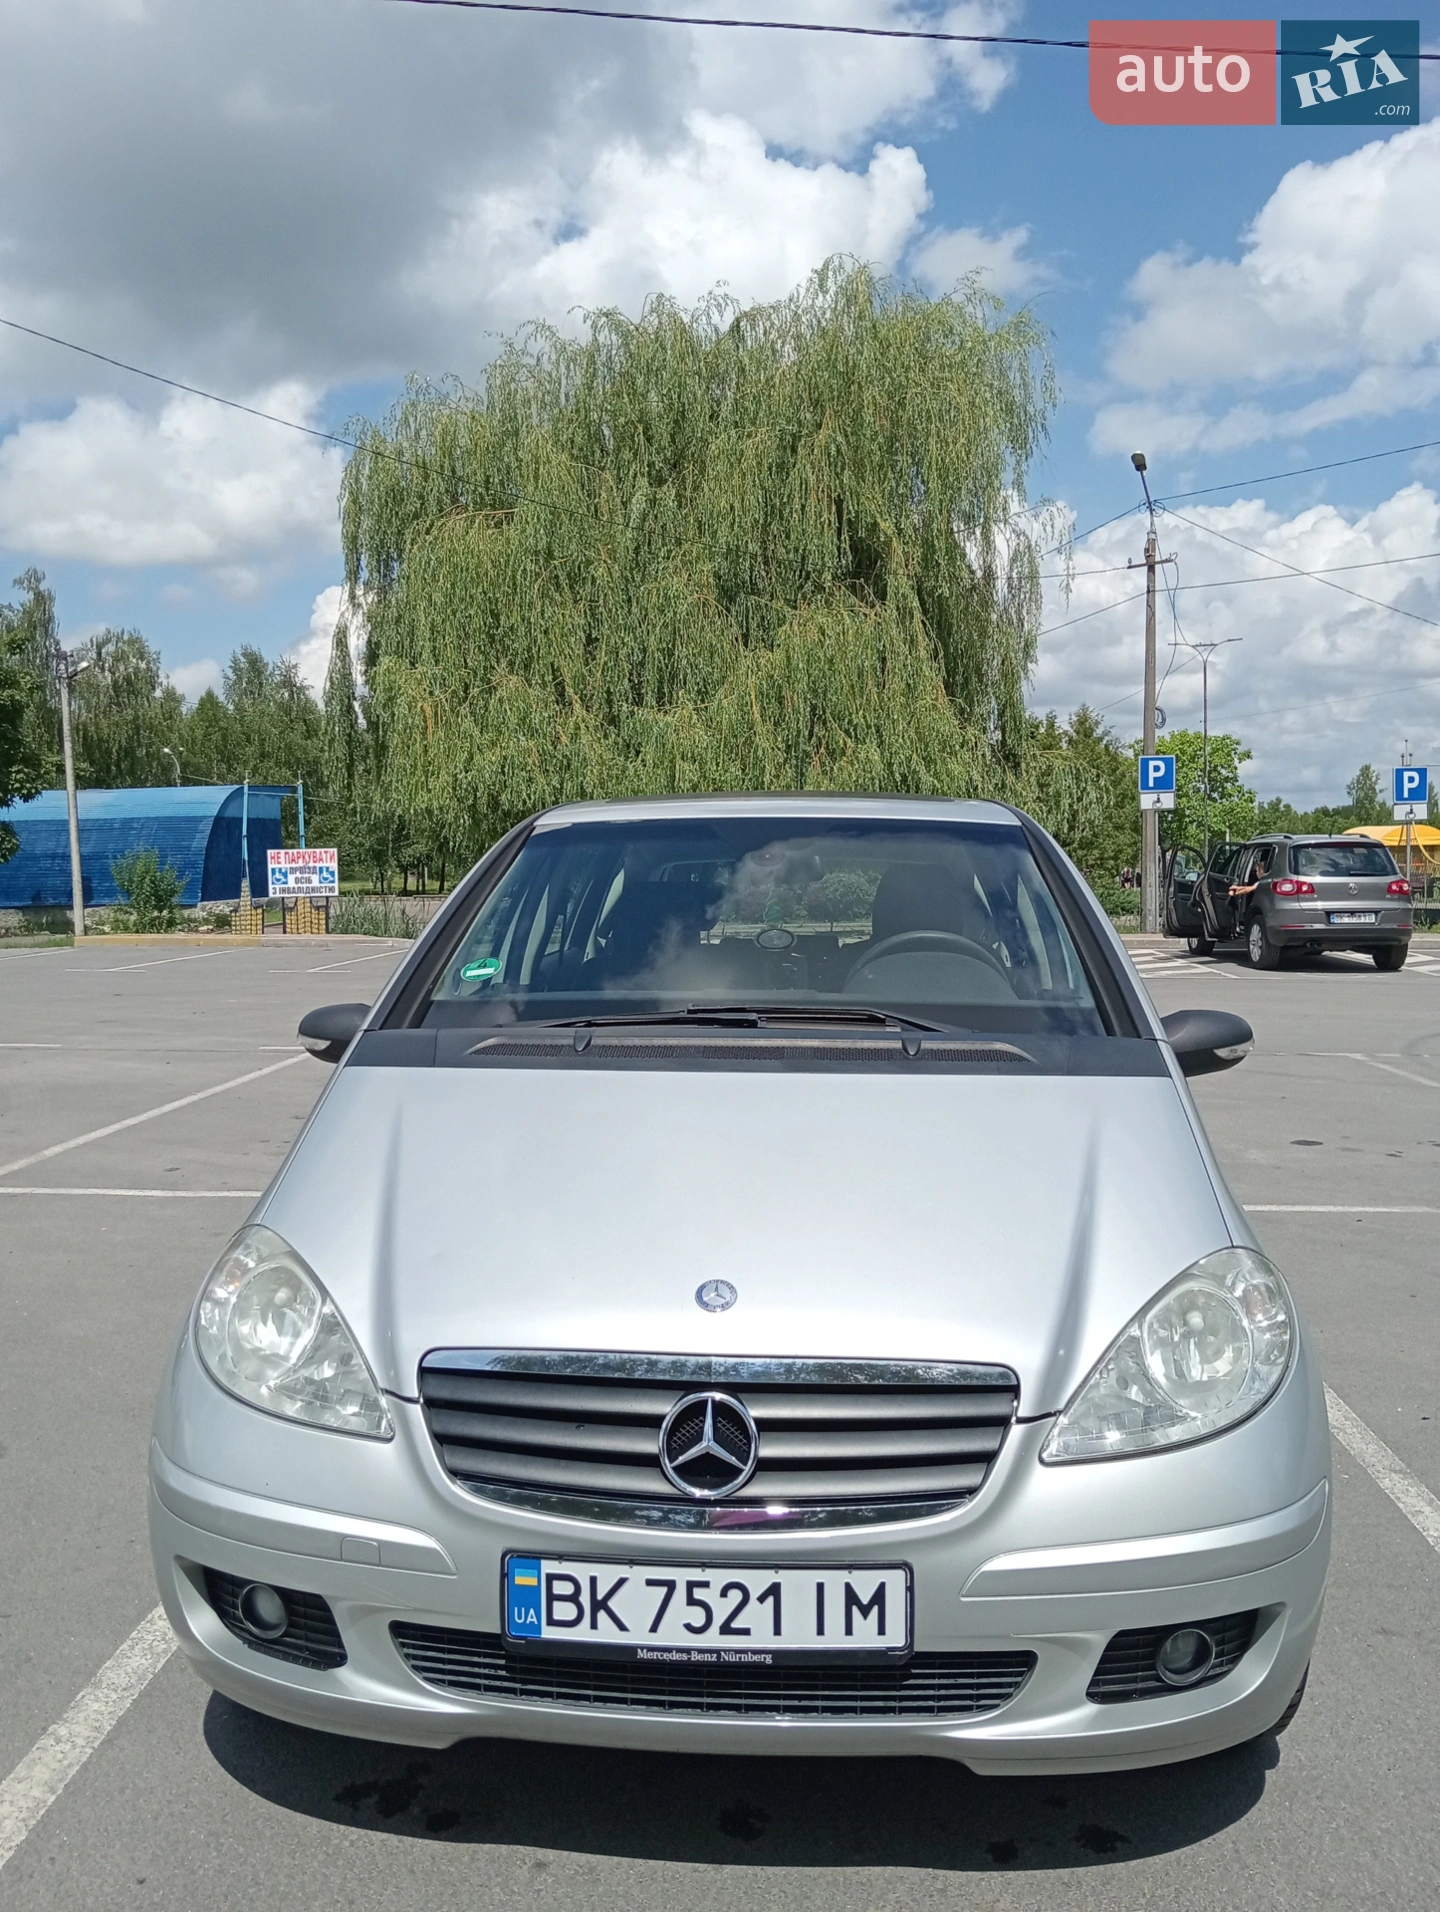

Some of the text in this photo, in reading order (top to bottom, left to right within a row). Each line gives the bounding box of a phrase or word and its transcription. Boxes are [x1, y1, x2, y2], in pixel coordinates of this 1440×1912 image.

[1148, 760, 1166, 788] P
[1403, 771, 1420, 799] P
[270, 850, 336, 865] НЕ ПАРКУВАТИ
[289, 865, 318, 875] ПРОЇЗД
[294, 876, 313, 885] ОСІБ
[272, 886, 336, 895] З ІНВАЛІДНІСТЮ
[477, 958, 488, 968] 4
[545, 1571, 887, 1637] BK 7521 IM
[514, 1606, 538, 1625] UA
[636, 1648, 773, 1664] Mercedes-Benz Nürnberg
